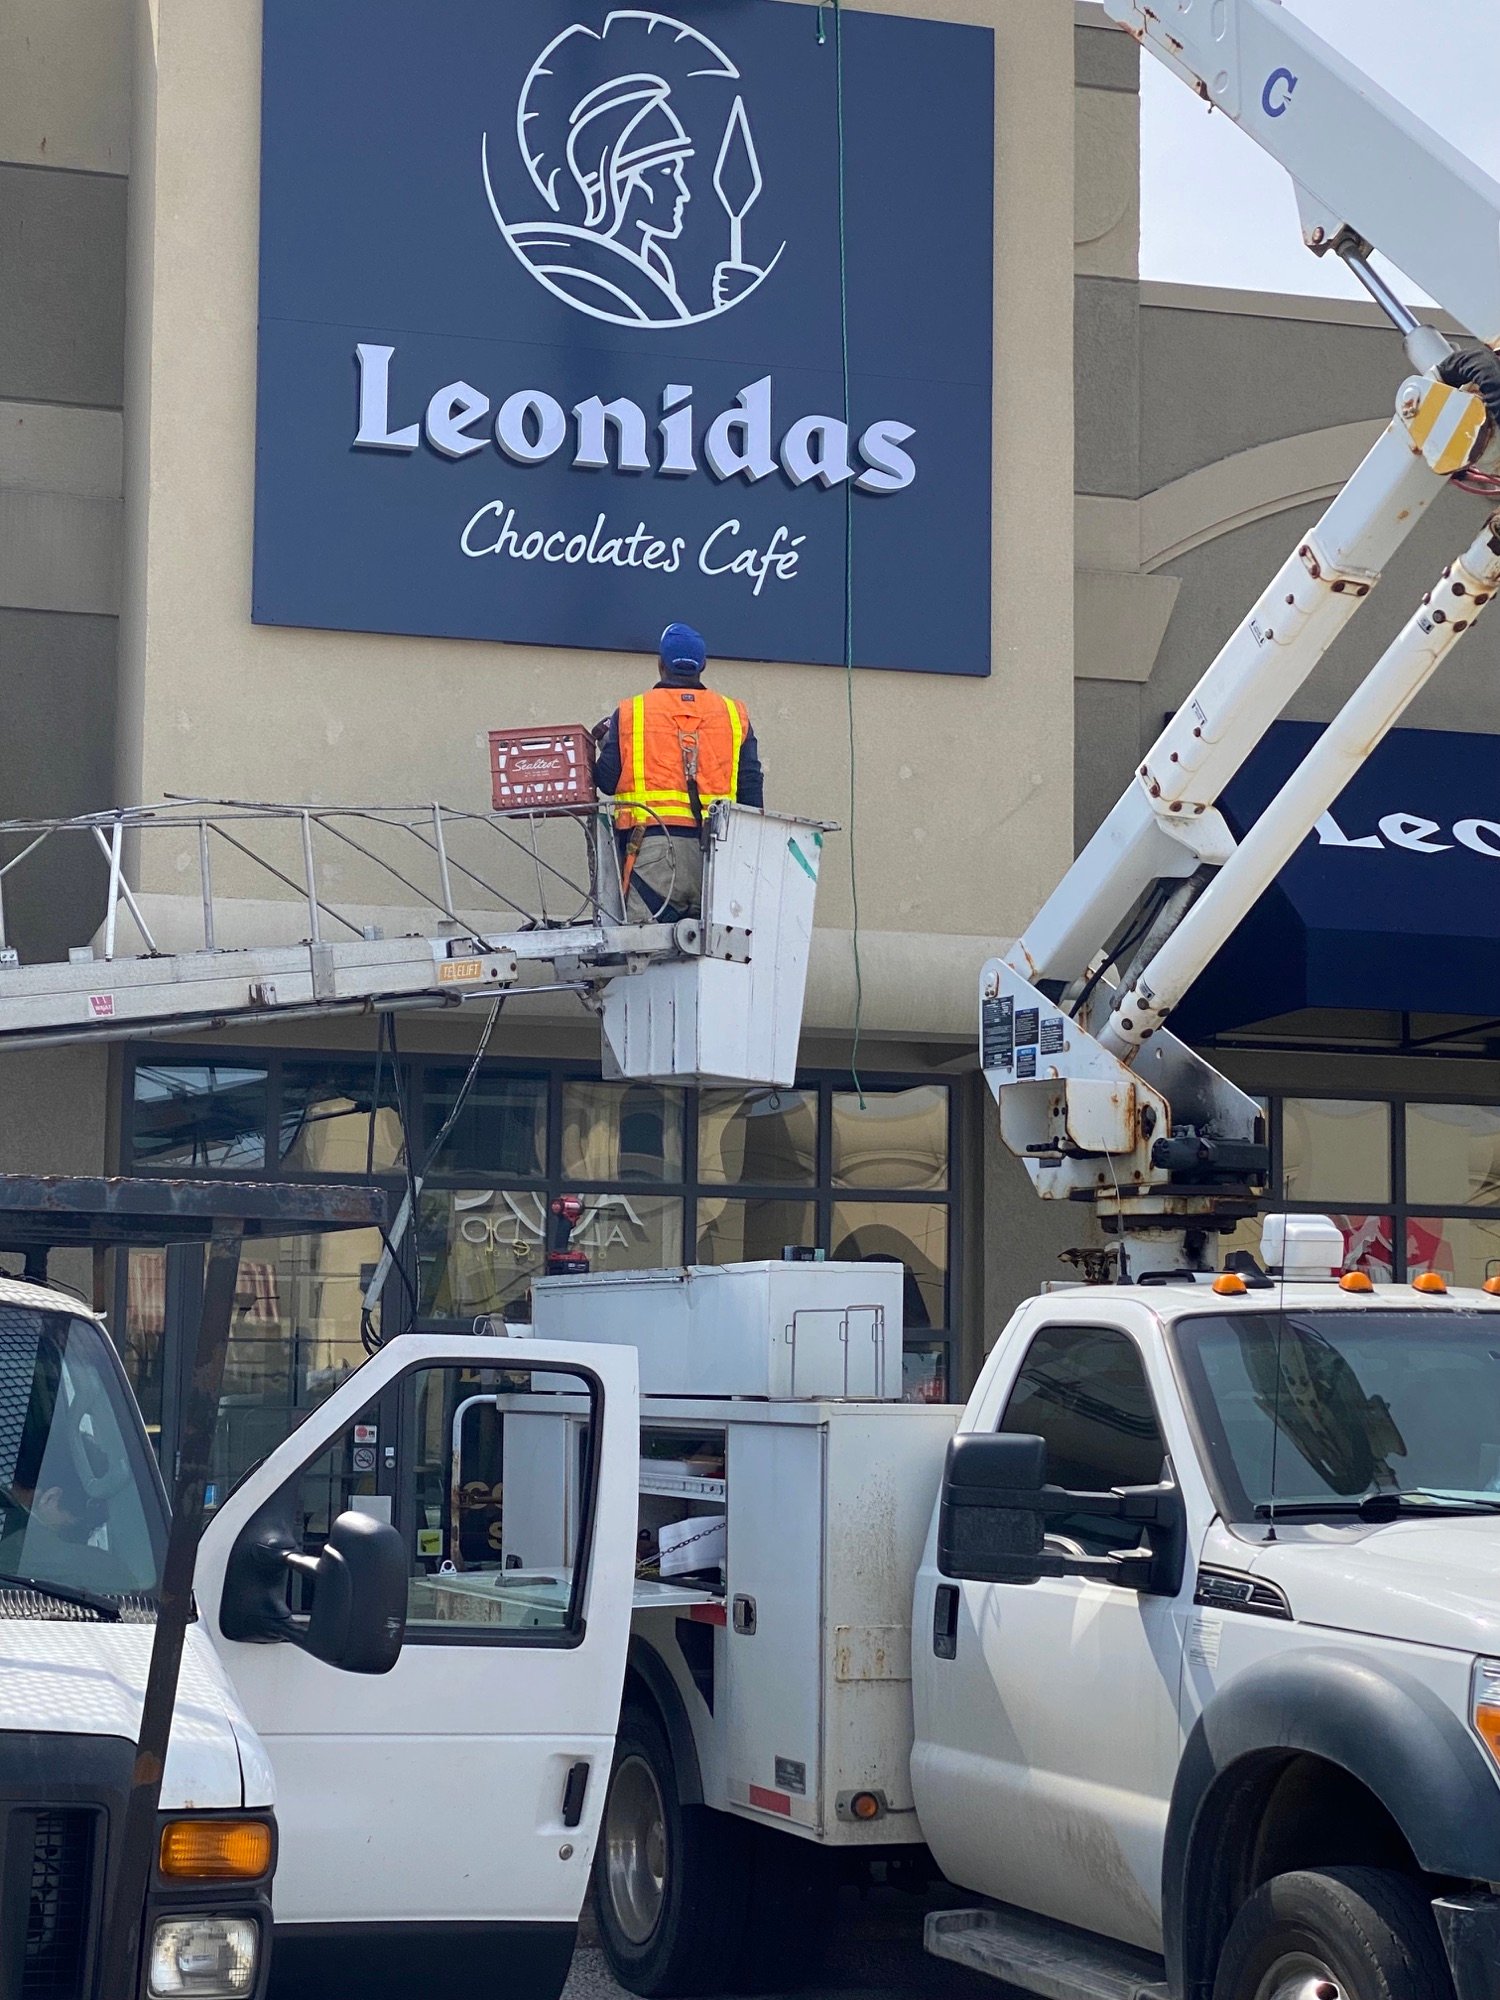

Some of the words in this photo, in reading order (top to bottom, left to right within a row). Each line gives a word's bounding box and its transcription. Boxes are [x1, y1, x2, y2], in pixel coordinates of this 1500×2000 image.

[353, 342, 917, 494] Leonidas
[460, 500, 686, 574] Chocolates
[699, 518, 806, 597] Café
[512, 759, 561, 772] Sealtest
[443, 963, 480, 978] TELELIFT
